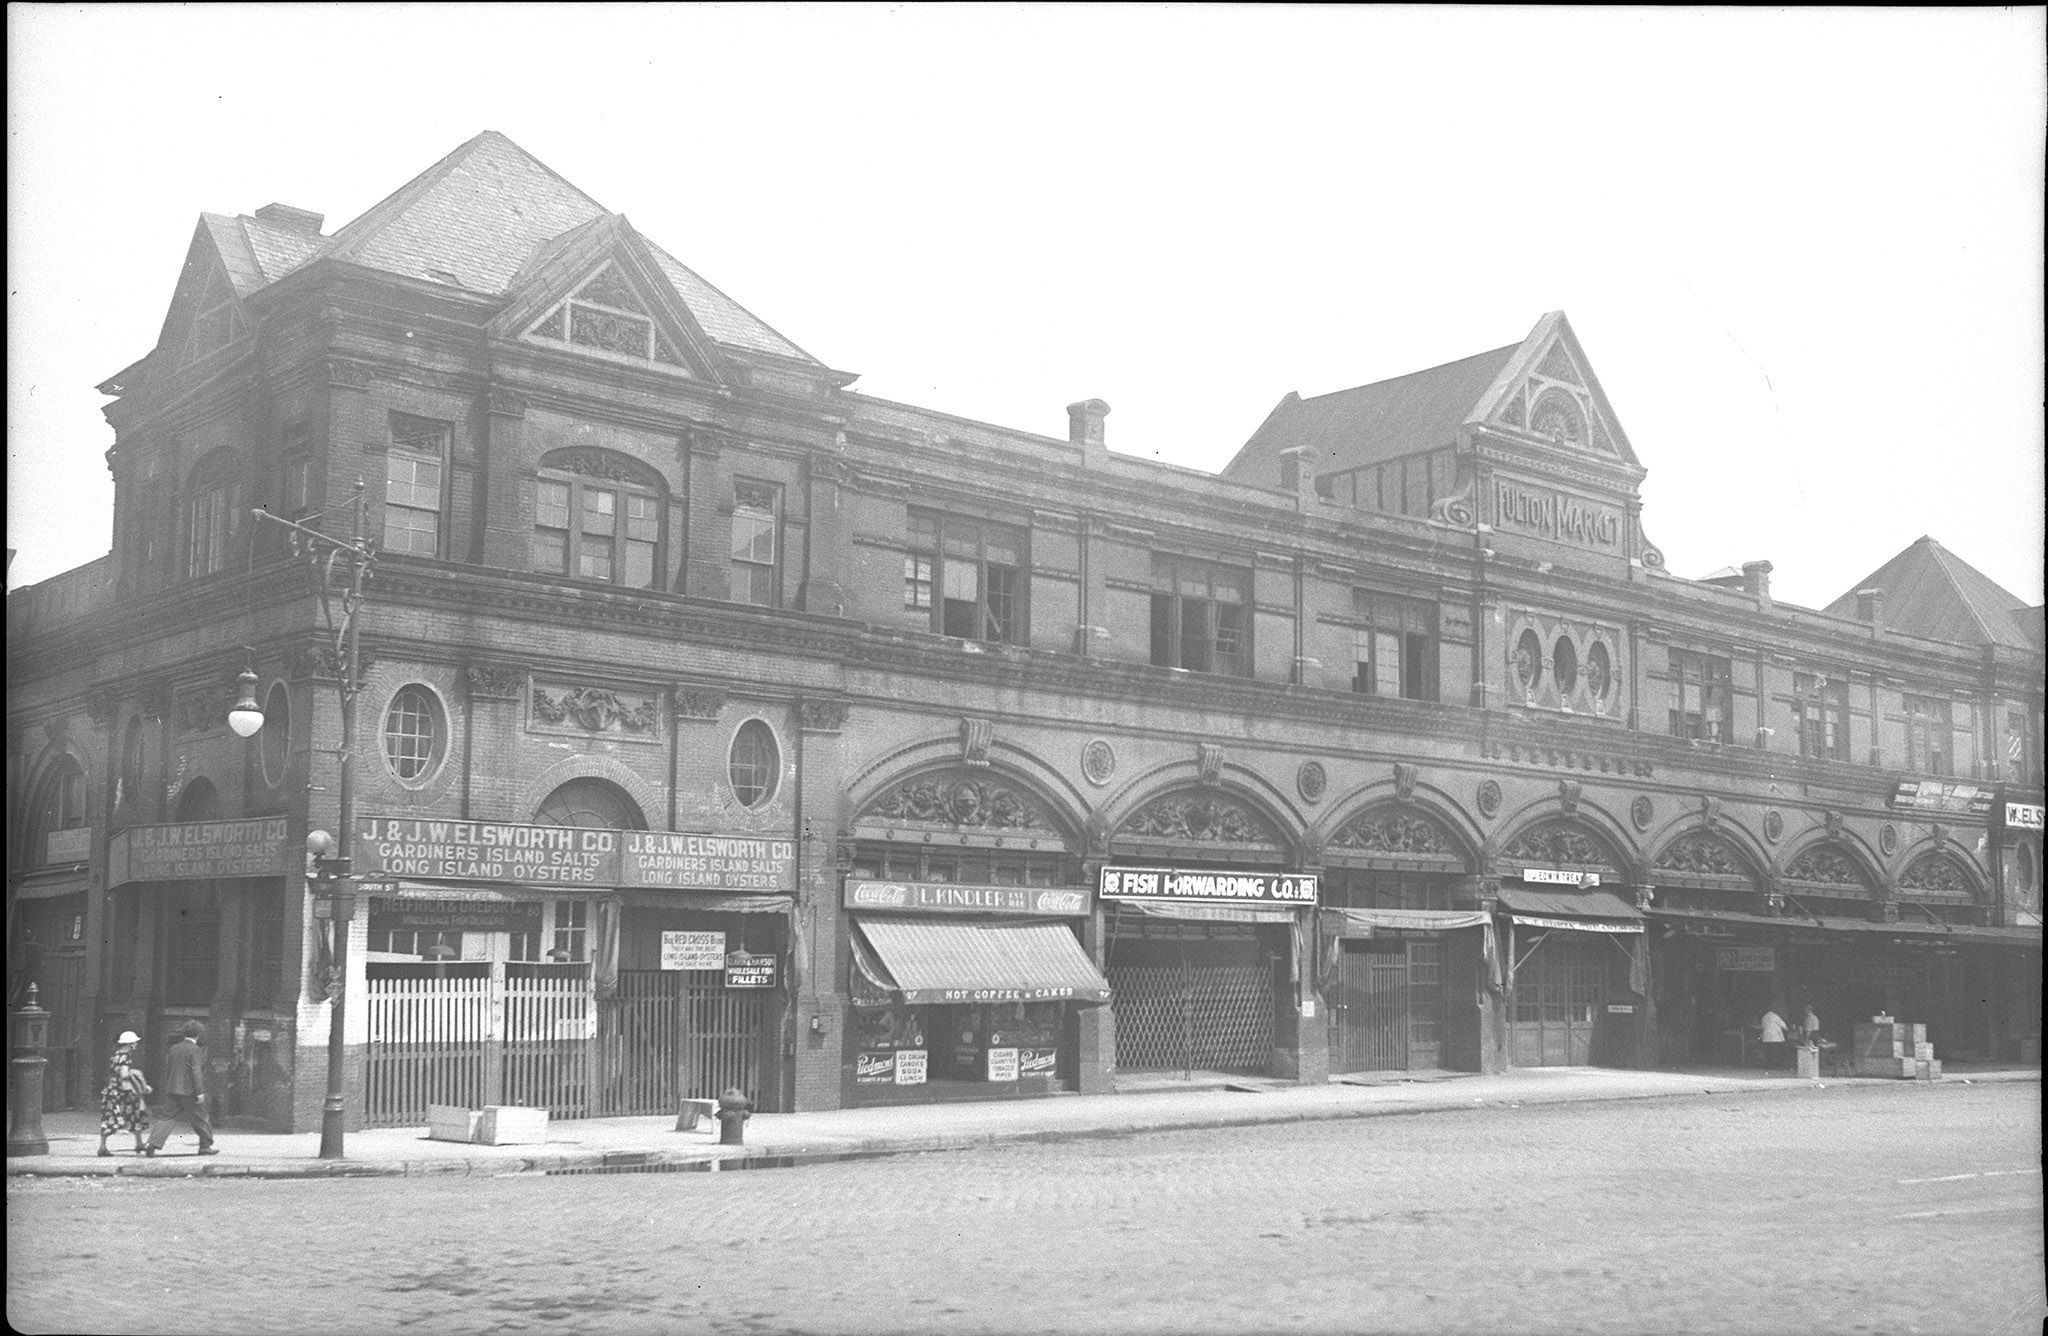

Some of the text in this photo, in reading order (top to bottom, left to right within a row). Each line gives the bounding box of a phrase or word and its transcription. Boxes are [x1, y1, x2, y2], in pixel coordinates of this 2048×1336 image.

[1495, 481, 1552, 535] FULTON
[205, 845, 241, 860] ISLAND
[486, 848, 544, 864] ISLAND
[174, 861, 213, 876] ISLAND
[217, 858, 272, 875] OYSTERS
[382, 859, 595, 881] LONG ISLAND OYSTERS
[710, 858, 749, 872] ISLAND
[642, 870, 777, 888] LONG ISLAND OYSTERS
[1122, 873, 1159, 894] FISH
[1164, 874, 1265, 898] FORWARDING
[358, 883, 383, 891] SOUTH
[921, 888, 934, 905] L.
[936, 888, 1004, 907] KINDLER
[689, 934, 709, 945] CROSS
[728, 967, 760, 975] WHOLESALE
[732, 975, 768, 984] FILLETS
[945, 990, 968, 999] HOT
[974, 990, 1019, 999] COFFEE
[1034, 987, 1073, 998] CAKES
